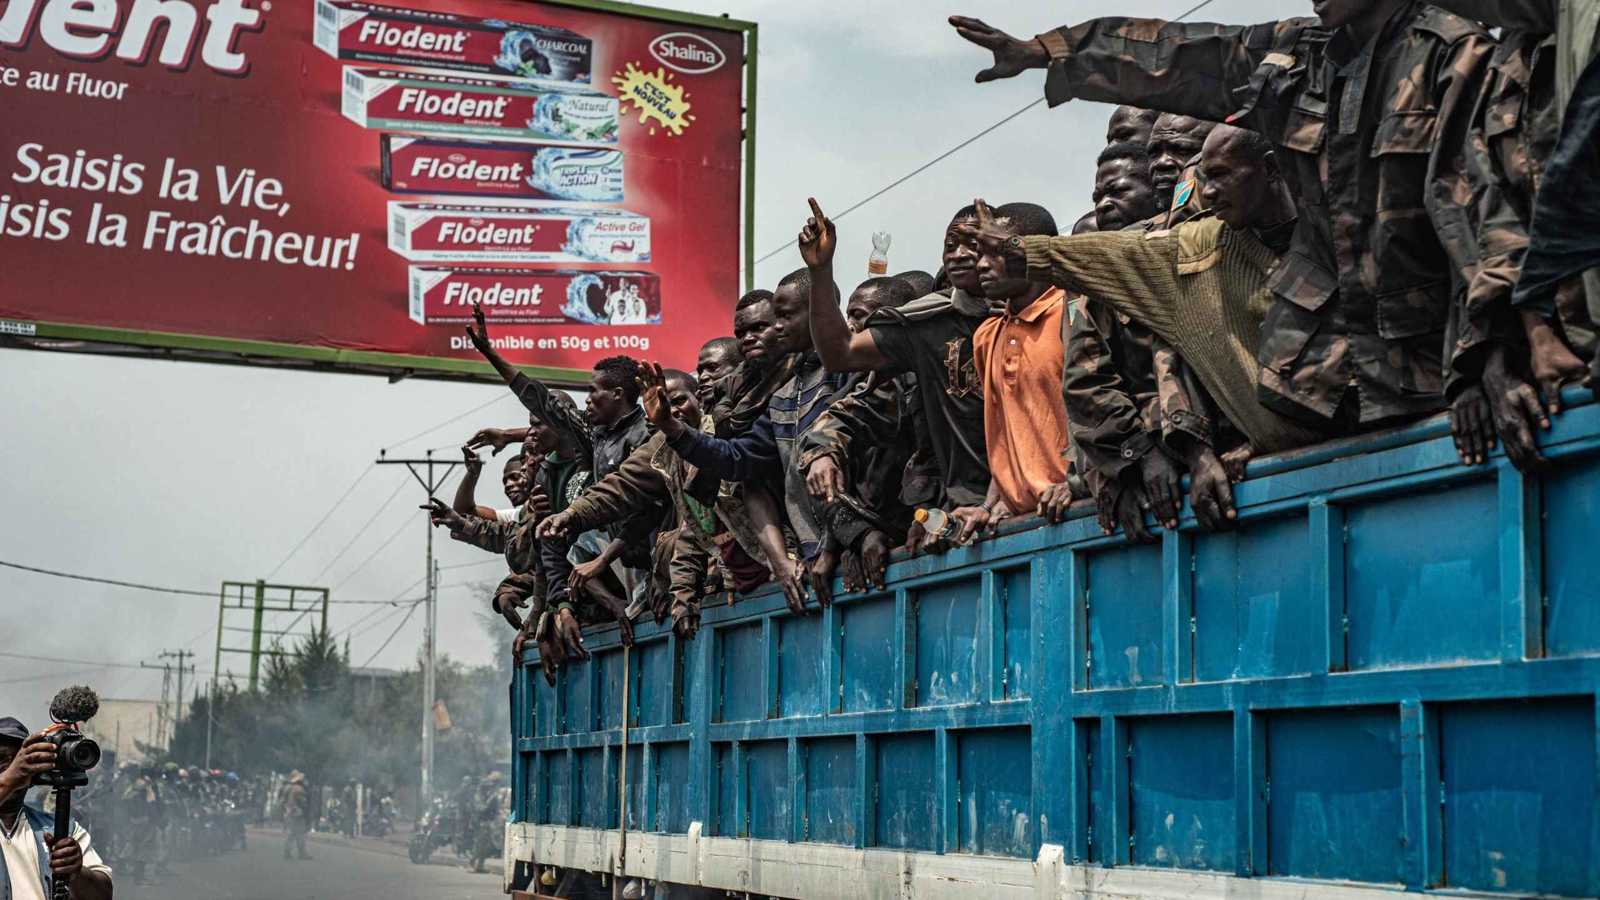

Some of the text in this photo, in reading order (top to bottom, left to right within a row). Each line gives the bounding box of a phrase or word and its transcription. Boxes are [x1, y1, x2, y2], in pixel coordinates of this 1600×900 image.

[358, 19, 466, 53] Flodent
[659, 40, 716, 64] Shalina
[26, 70, 59, 91] au
[66, 72, 128, 100] Fluor
[397, 87, 507, 118] Flodent
[567, 97, 610, 113] Natural
[12, 143, 291, 217] Saisis la Vie,
[410, 156, 524, 182] Flodent
[559, 174, 599, 187] ACTION
[86, 202, 128, 247] la
[142, 211, 360, 270] Fraîcheur!
[437, 221, 536, 244] Flodent
[594, 220, 646, 232] Active Gel
[443, 281, 544, 306] Flodent
[450, 335, 650, 352] Disonible en 50g et 100g
